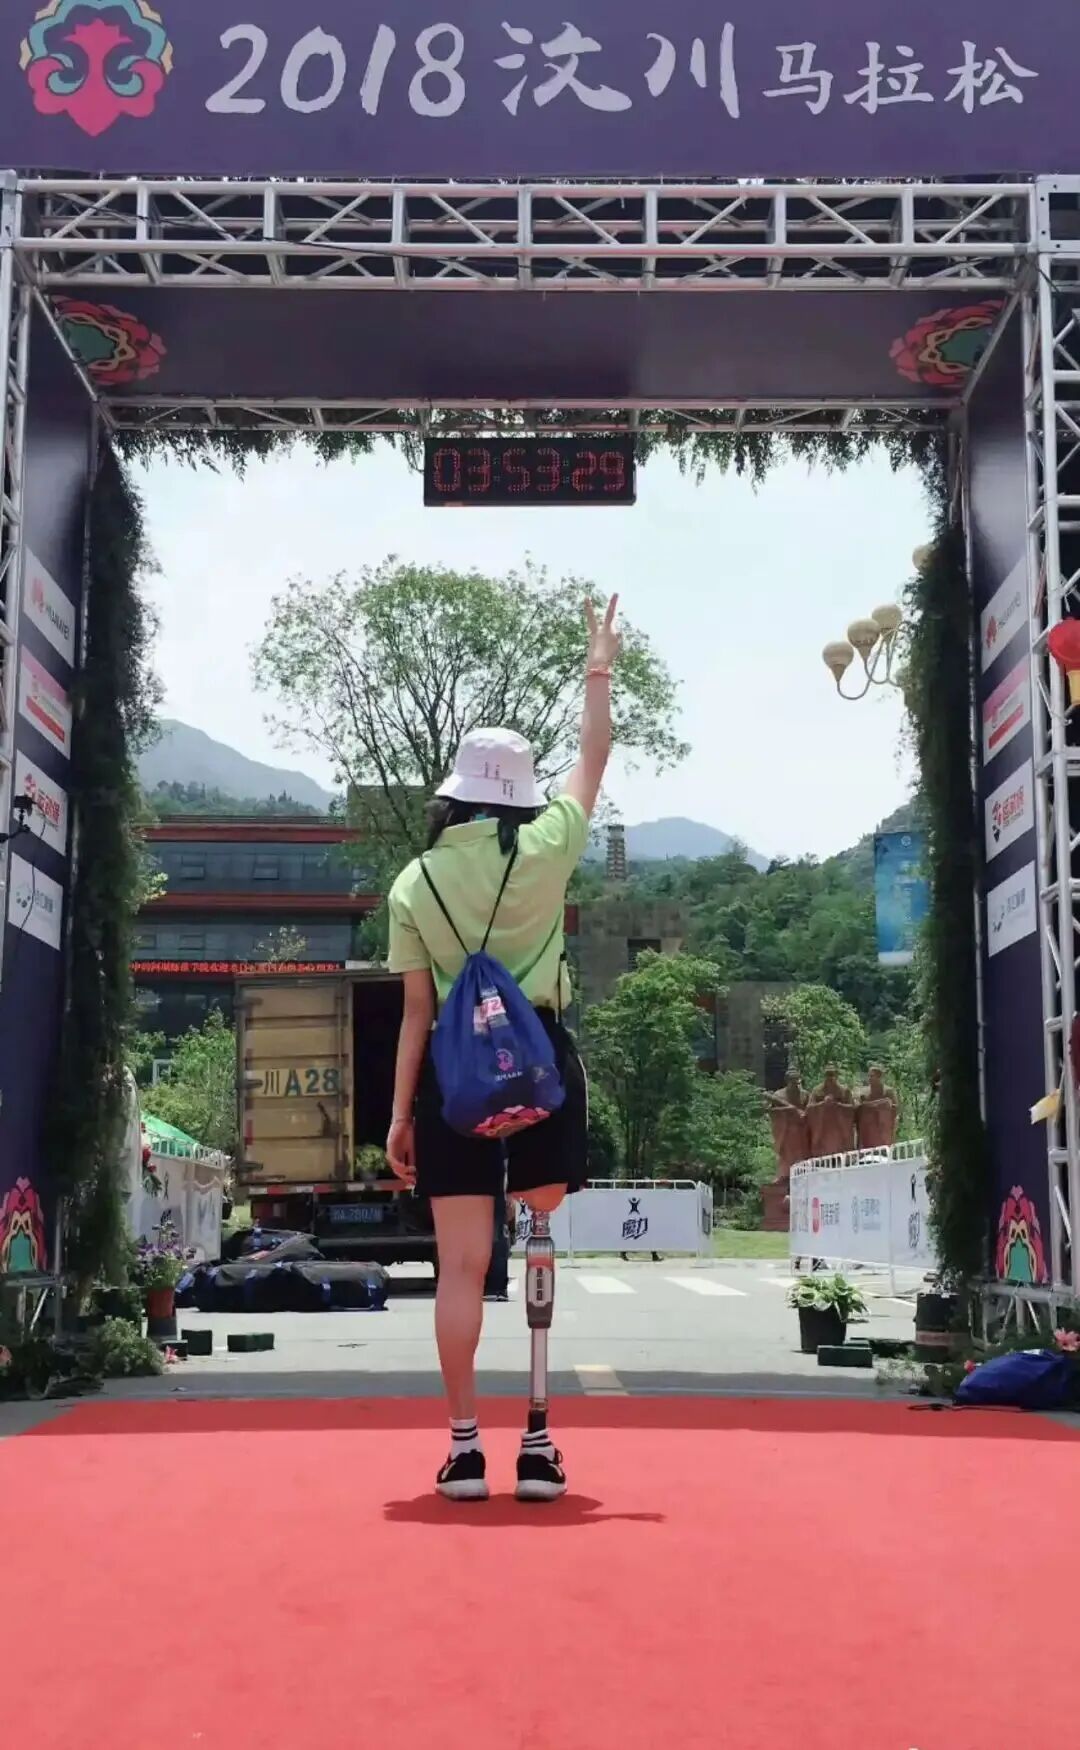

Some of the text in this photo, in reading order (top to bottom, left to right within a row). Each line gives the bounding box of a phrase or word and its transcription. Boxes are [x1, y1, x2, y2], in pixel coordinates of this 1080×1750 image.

[205, 22, 1039, 119] 2018 汶川马拉松
[432, 447, 626, 492] 03:53:29
[262, 1067, 340, 1098] 川A28
